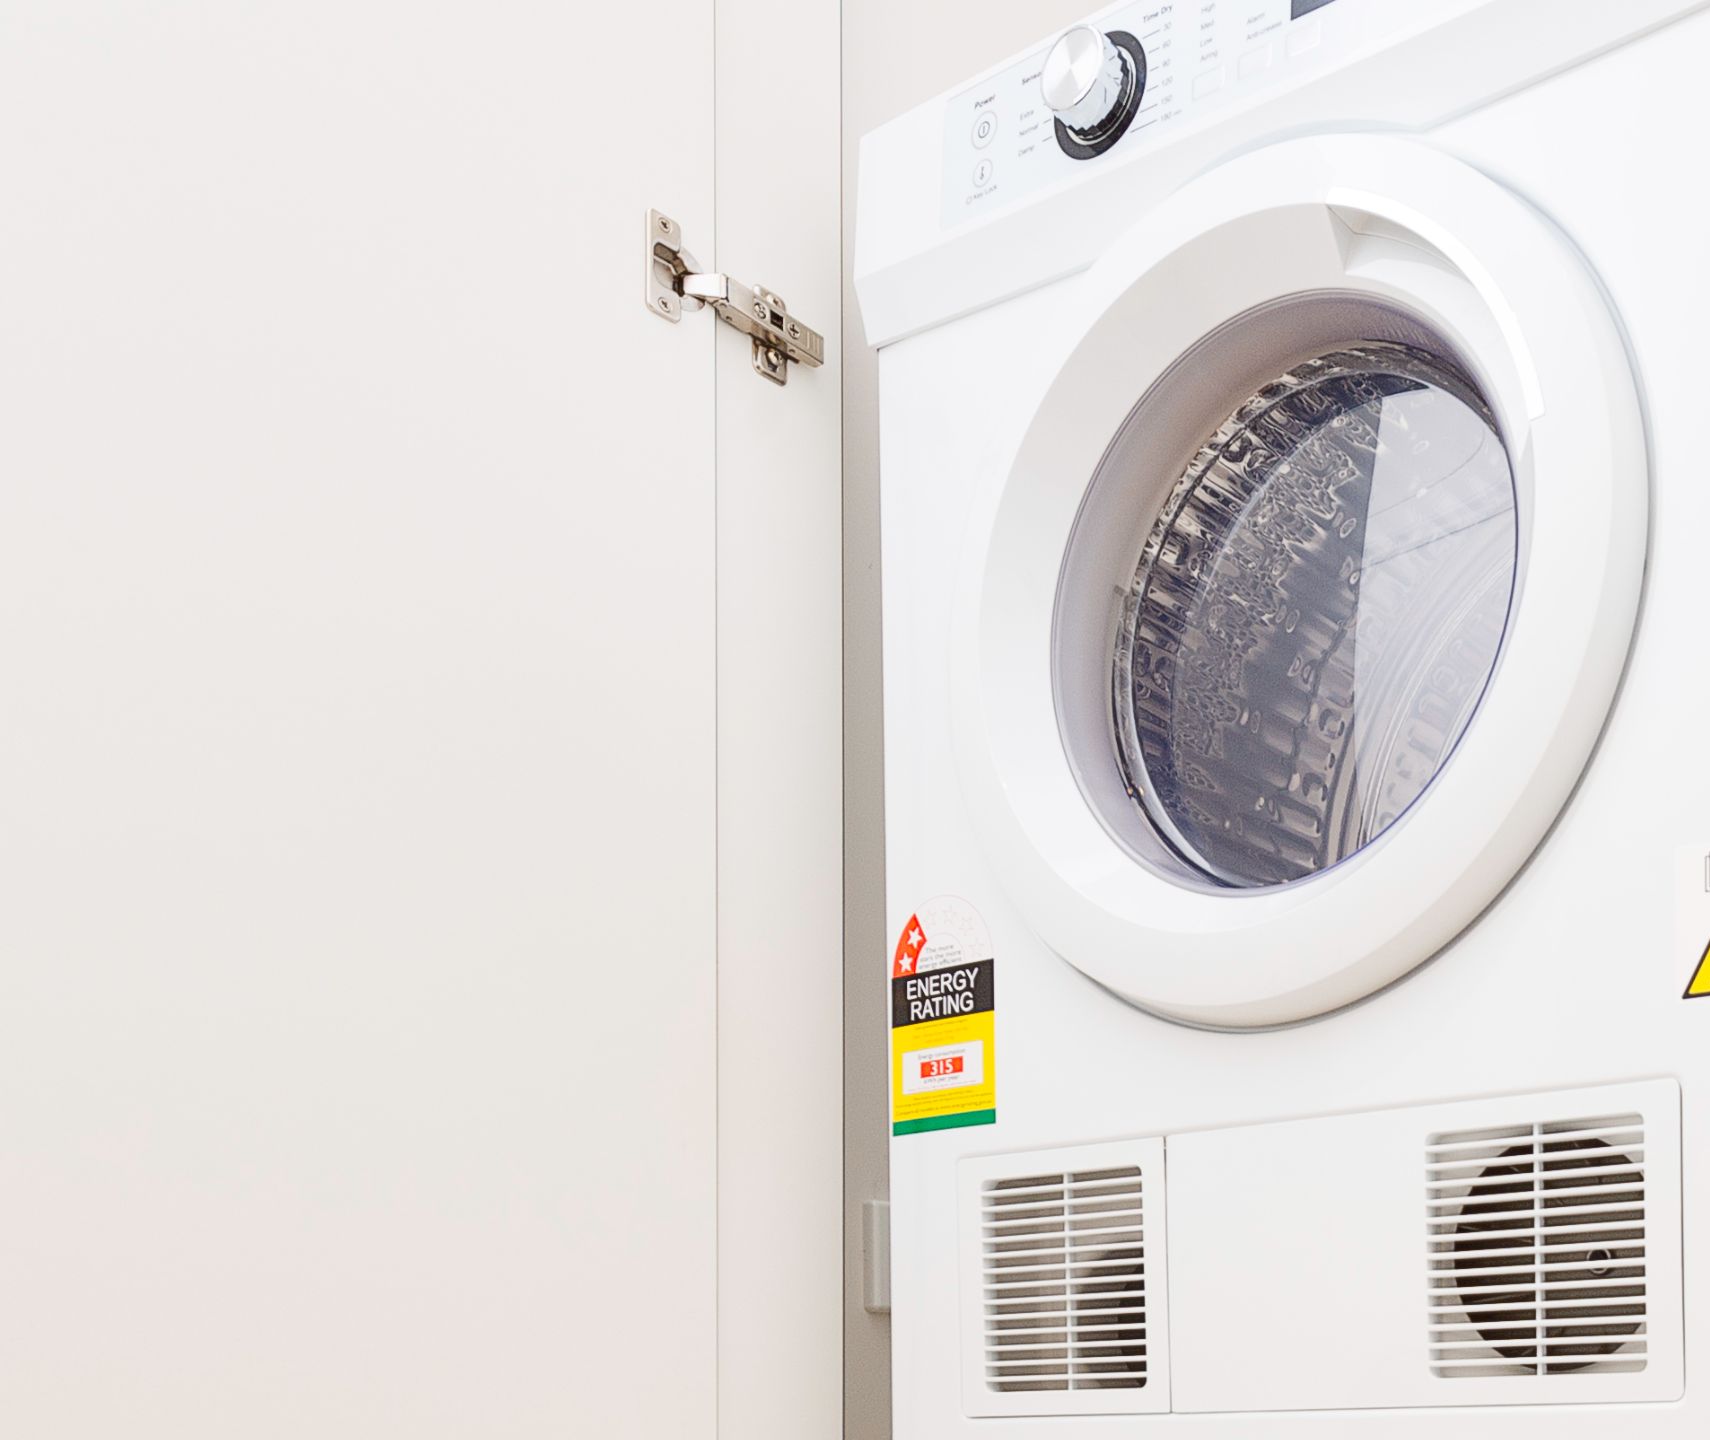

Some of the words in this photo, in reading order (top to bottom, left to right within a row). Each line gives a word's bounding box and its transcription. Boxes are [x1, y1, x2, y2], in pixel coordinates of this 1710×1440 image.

[1143, 11, 1159, 23] Time
[1161, 5, 1172, 16] Dry
[975, 94, 996, 109] Power
[1019, 123, 1039, 137] Normal
[906, 967, 979, 1001] ENERGY
[910, 991, 974, 1022] RATING
[930, 1058, 953, 1076] 315
